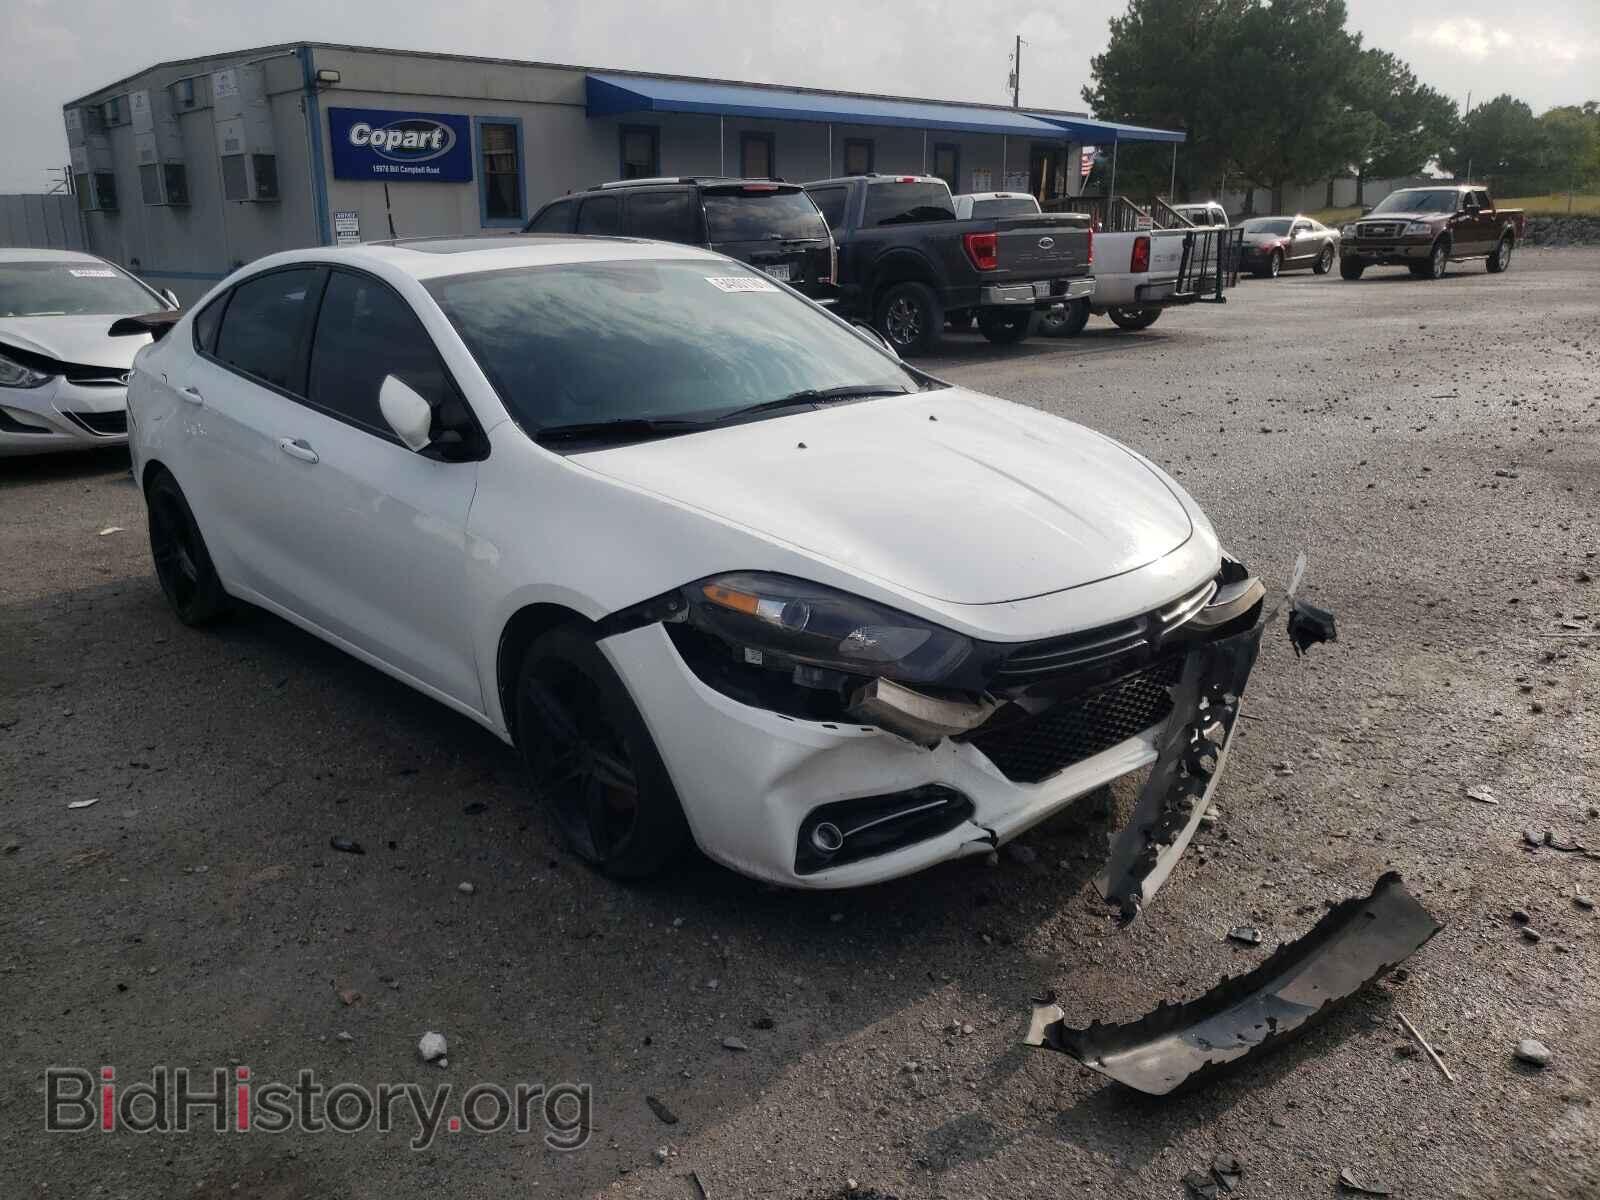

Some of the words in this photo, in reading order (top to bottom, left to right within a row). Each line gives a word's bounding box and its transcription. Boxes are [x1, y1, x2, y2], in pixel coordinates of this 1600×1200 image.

[349, 122, 443, 152] Copart
[400, 165, 426, 176] Campbell
[426, 166, 440, 175] Road
